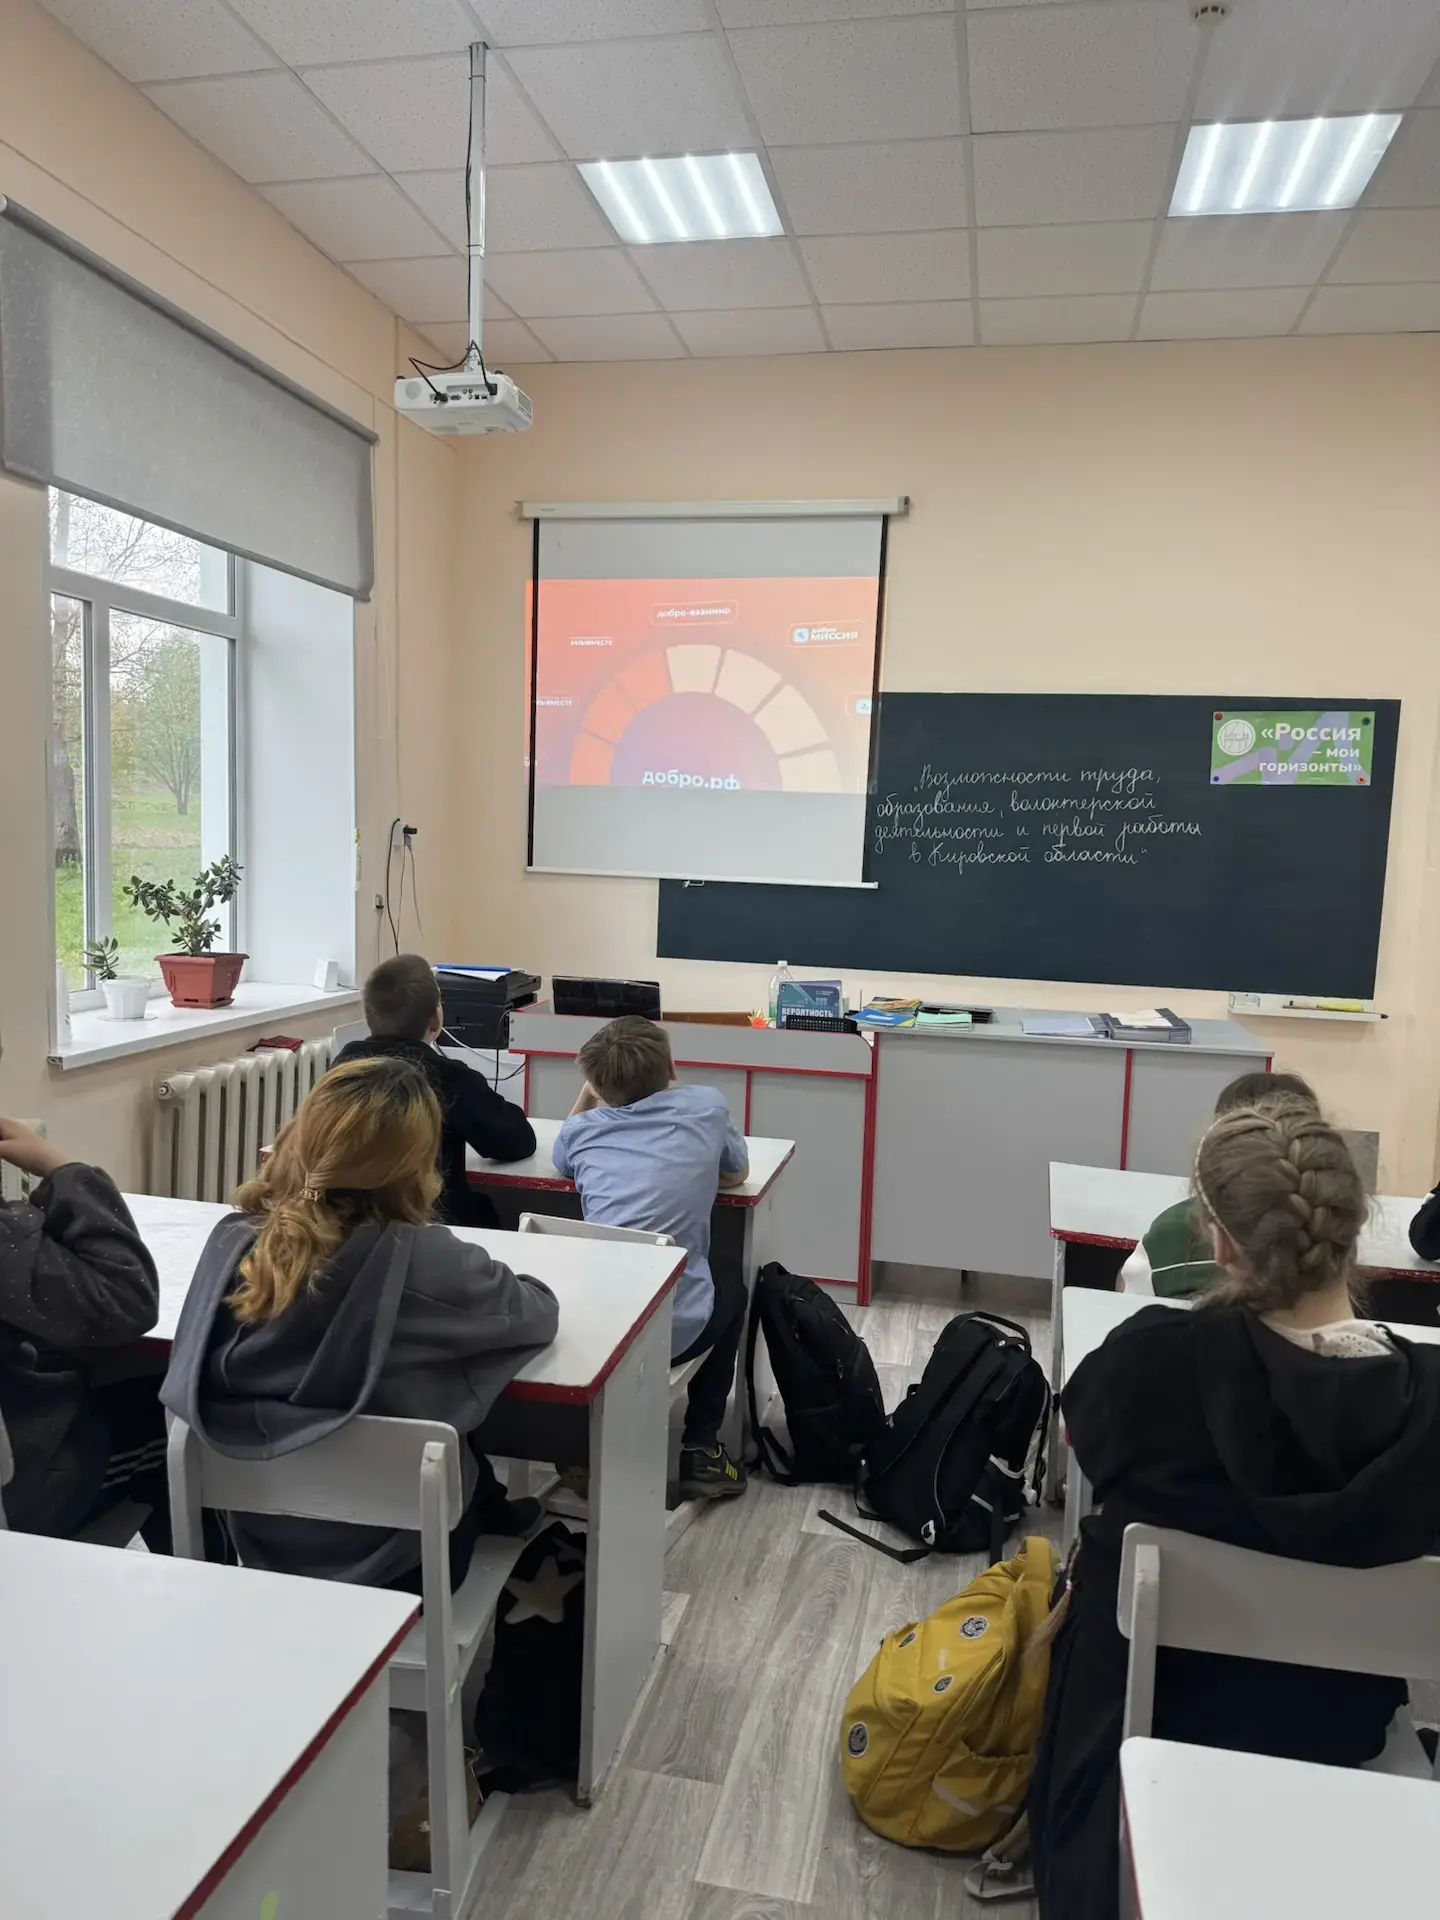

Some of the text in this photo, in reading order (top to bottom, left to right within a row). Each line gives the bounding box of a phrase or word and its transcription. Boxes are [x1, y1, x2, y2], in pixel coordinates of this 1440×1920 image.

[810, 631, 858, 641] МИССИЯ
[1261, 723, 1361, 741] «Россия
[1326, 748, 1360, 758] мои
[1259, 762, 1362, 775] горизонты»
[642, 769, 742, 790] добро.рф
[1080, 767, 1161, 794] труда,
[874, 814, 1202, 854] деятельности и первой работы
[909, 841, 922, 864] в
[927, 840, 1032, 875] Кировской
[781, 1007, 834, 1018] ВЕРОЯТНОСТЬ
